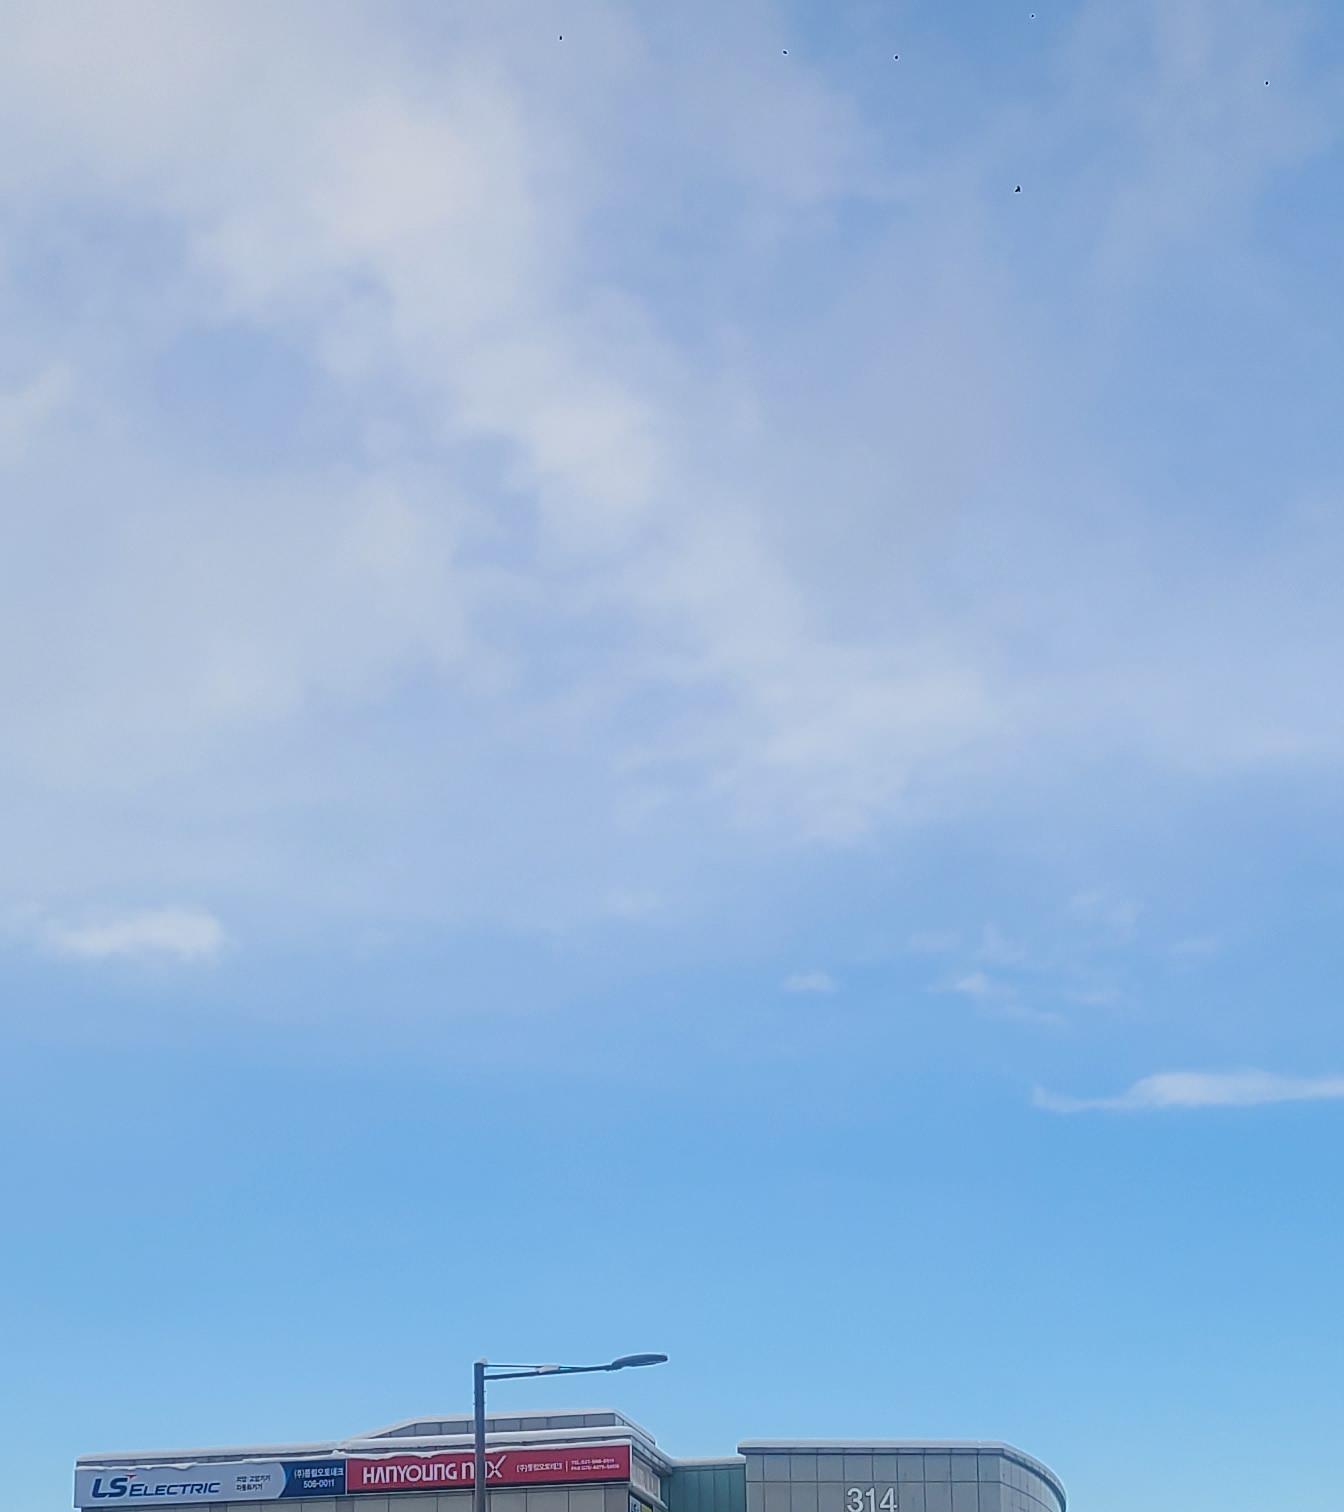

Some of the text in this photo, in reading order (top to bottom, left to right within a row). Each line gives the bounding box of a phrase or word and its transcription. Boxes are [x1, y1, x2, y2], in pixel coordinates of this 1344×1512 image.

[363, 1464, 457, 1484] HANYOUNG
[92, 1475, 221, 1498] LS ELECTRIC
